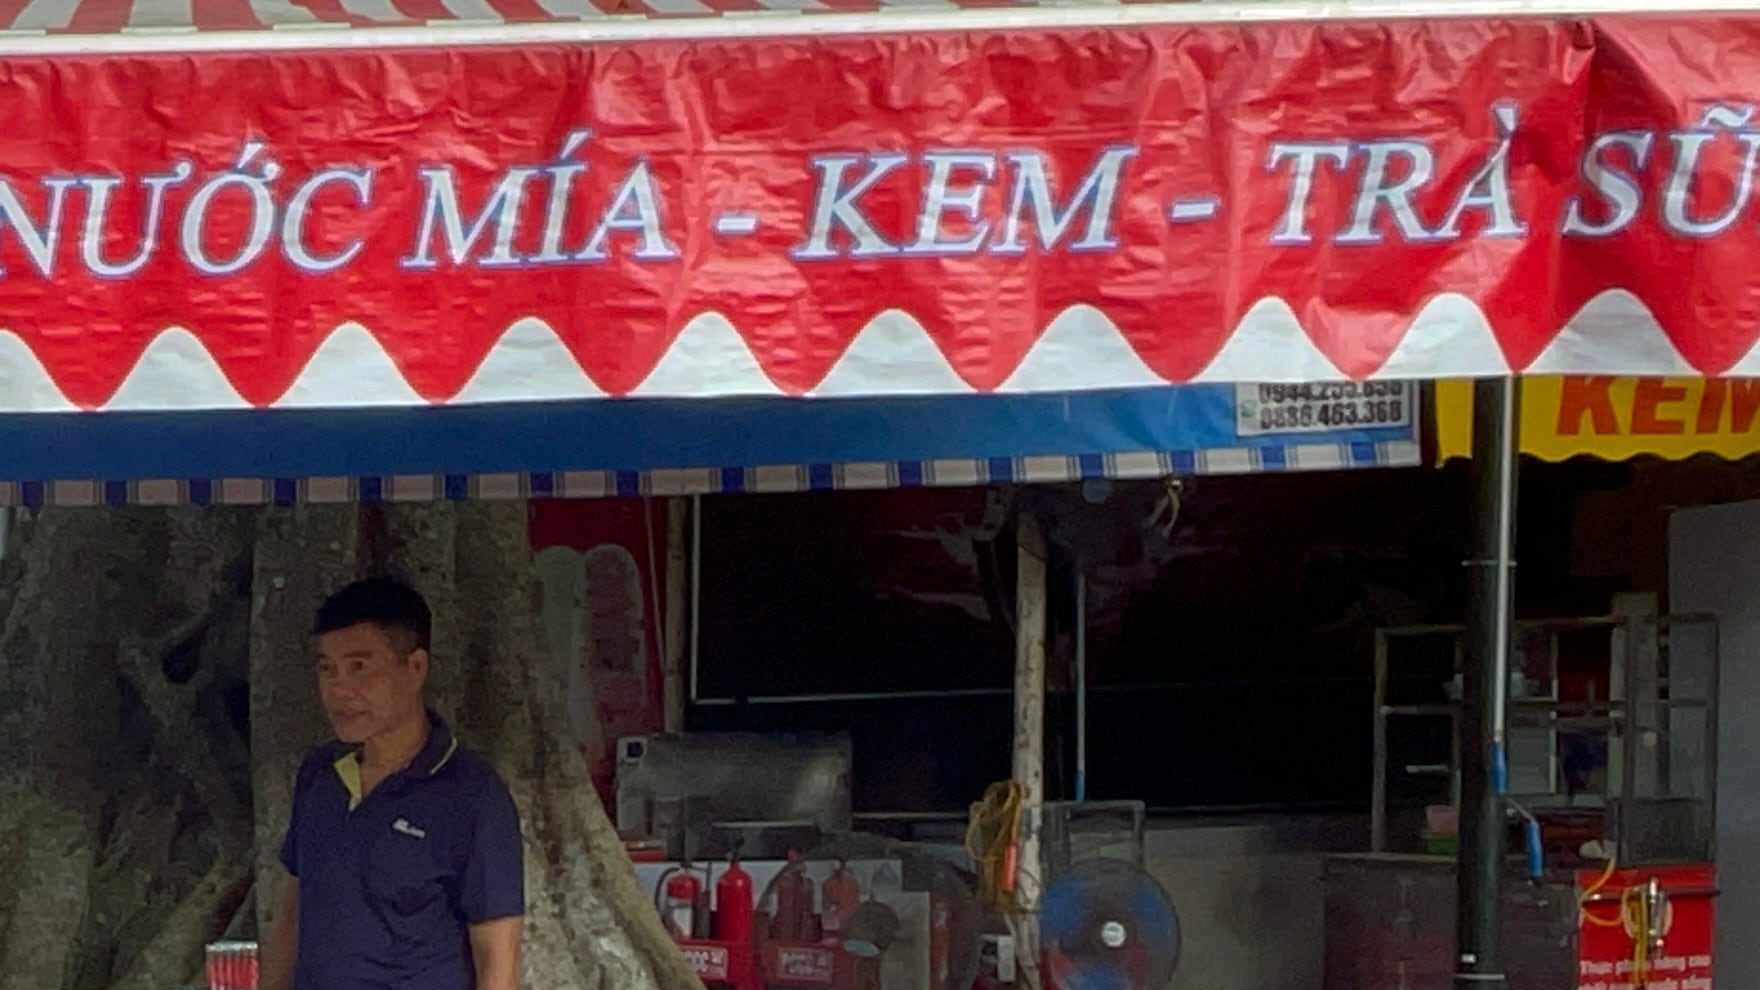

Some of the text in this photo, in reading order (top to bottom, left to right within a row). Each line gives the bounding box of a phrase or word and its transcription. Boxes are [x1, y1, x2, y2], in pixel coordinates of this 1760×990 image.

[400, 130, 678, 270] MÍA
[790, 144, 1140, 262] KEM
[1265, 103, 1531, 246] TRÀ
[1556, 375, 1760, 435] KEM
